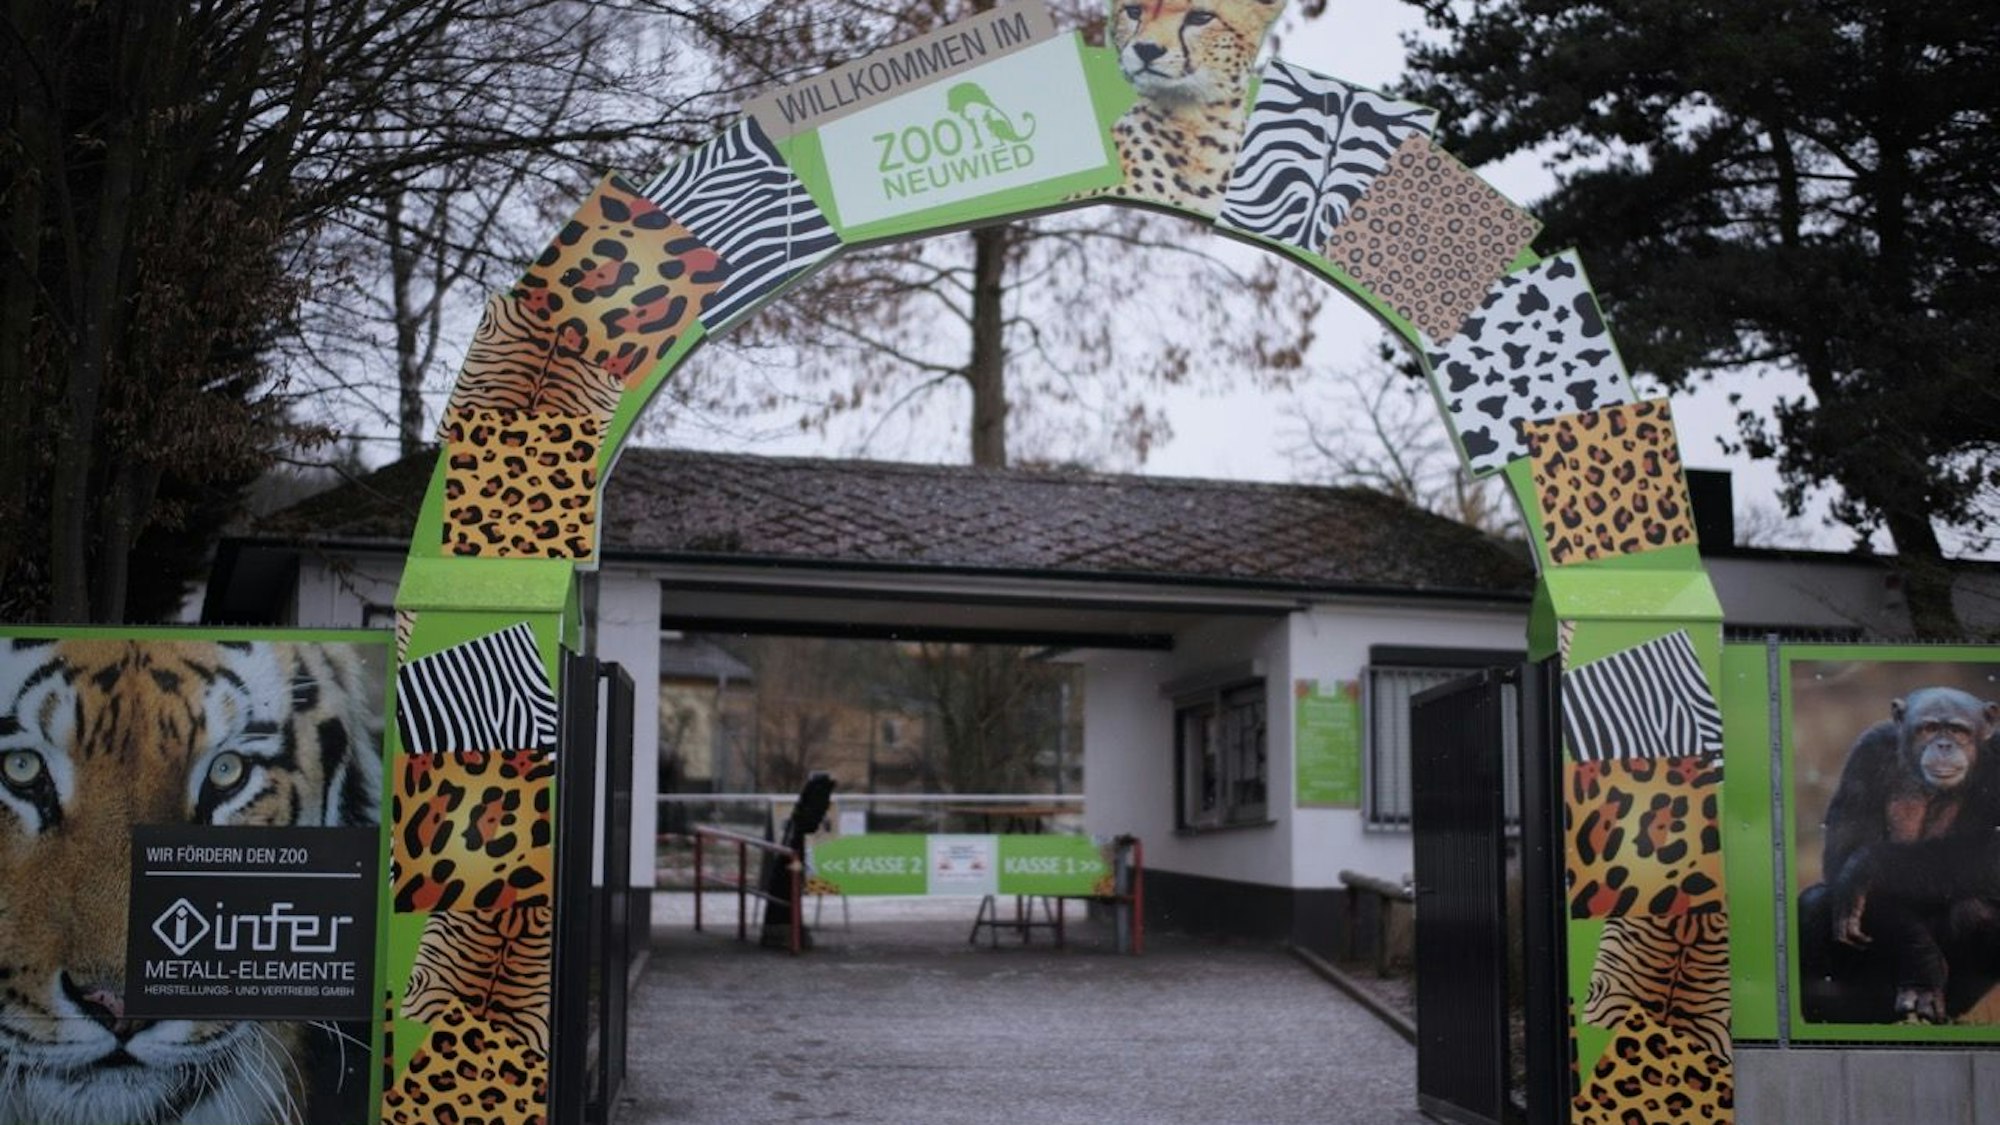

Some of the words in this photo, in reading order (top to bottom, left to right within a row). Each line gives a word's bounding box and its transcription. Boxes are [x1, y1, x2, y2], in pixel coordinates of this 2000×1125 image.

[776, 32, 988, 125] WILLKOMMEN
[993, 12, 1031, 49] IM
[872, 118, 963, 173] ZOO
[882, 143, 1035, 201] NEUWIED
[146, 847, 174, 863] WIR
[177, 845, 243, 864] FÖRDERN
[246, 849, 276, 864] DEN
[278, 849, 308, 865] ZOO
[851, 856, 906, 874] KASSE
[910, 856, 923, 873] 2
[1004, 856, 1061, 874] KASSE
[145, 960, 356, 981] METALL-ELEMENTE
[144, 985, 232, 997] HERSTELLUNGS-
[235, 986, 260, 997] UND
[262, 986, 320, 997] VERTRIEBS
